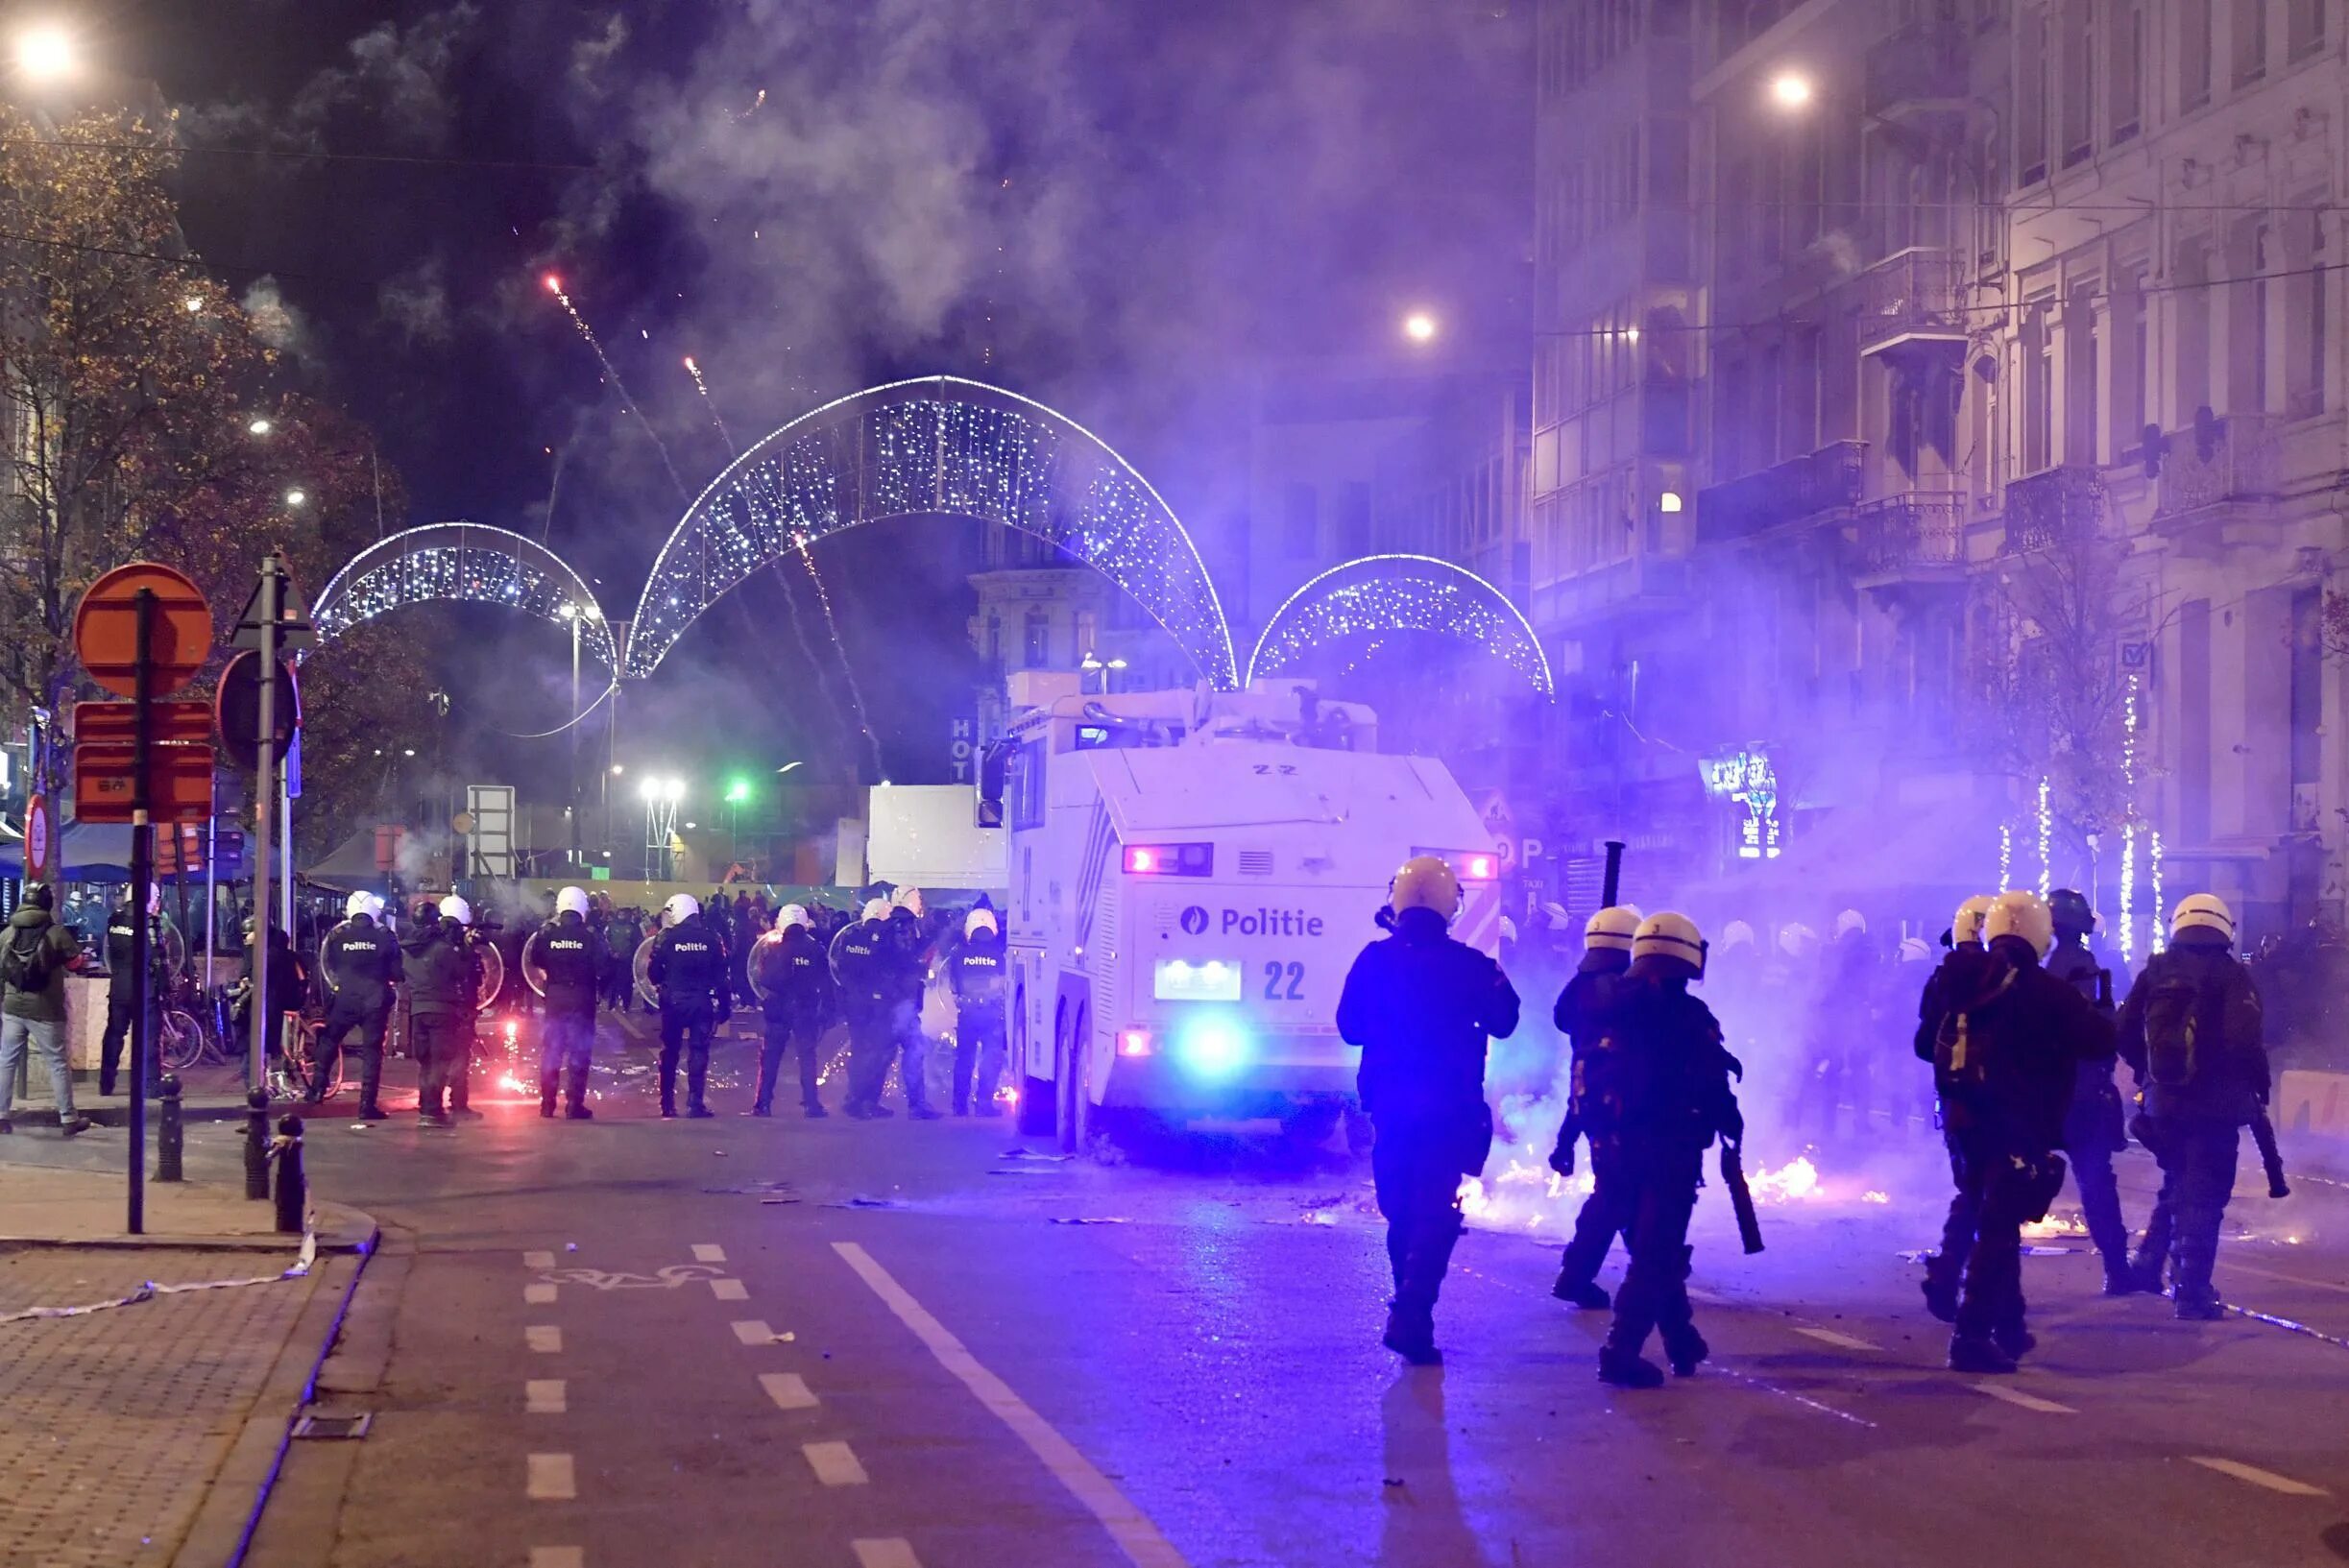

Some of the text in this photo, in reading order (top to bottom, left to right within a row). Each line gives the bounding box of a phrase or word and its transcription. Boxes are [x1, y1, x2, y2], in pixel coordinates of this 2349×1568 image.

[953, 719, 970, 784] HOT
[1522, 838, 1543, 868] P
[1222, 907, 1323, 936] Politie
[342, 942, 376, 952] Politie
[550, 940, 583, 950] Politie
[674, 943, 708, 953] Politie
[963, 956, 997, 966] Politie
[1264, 961, 1305, 1001] 22
